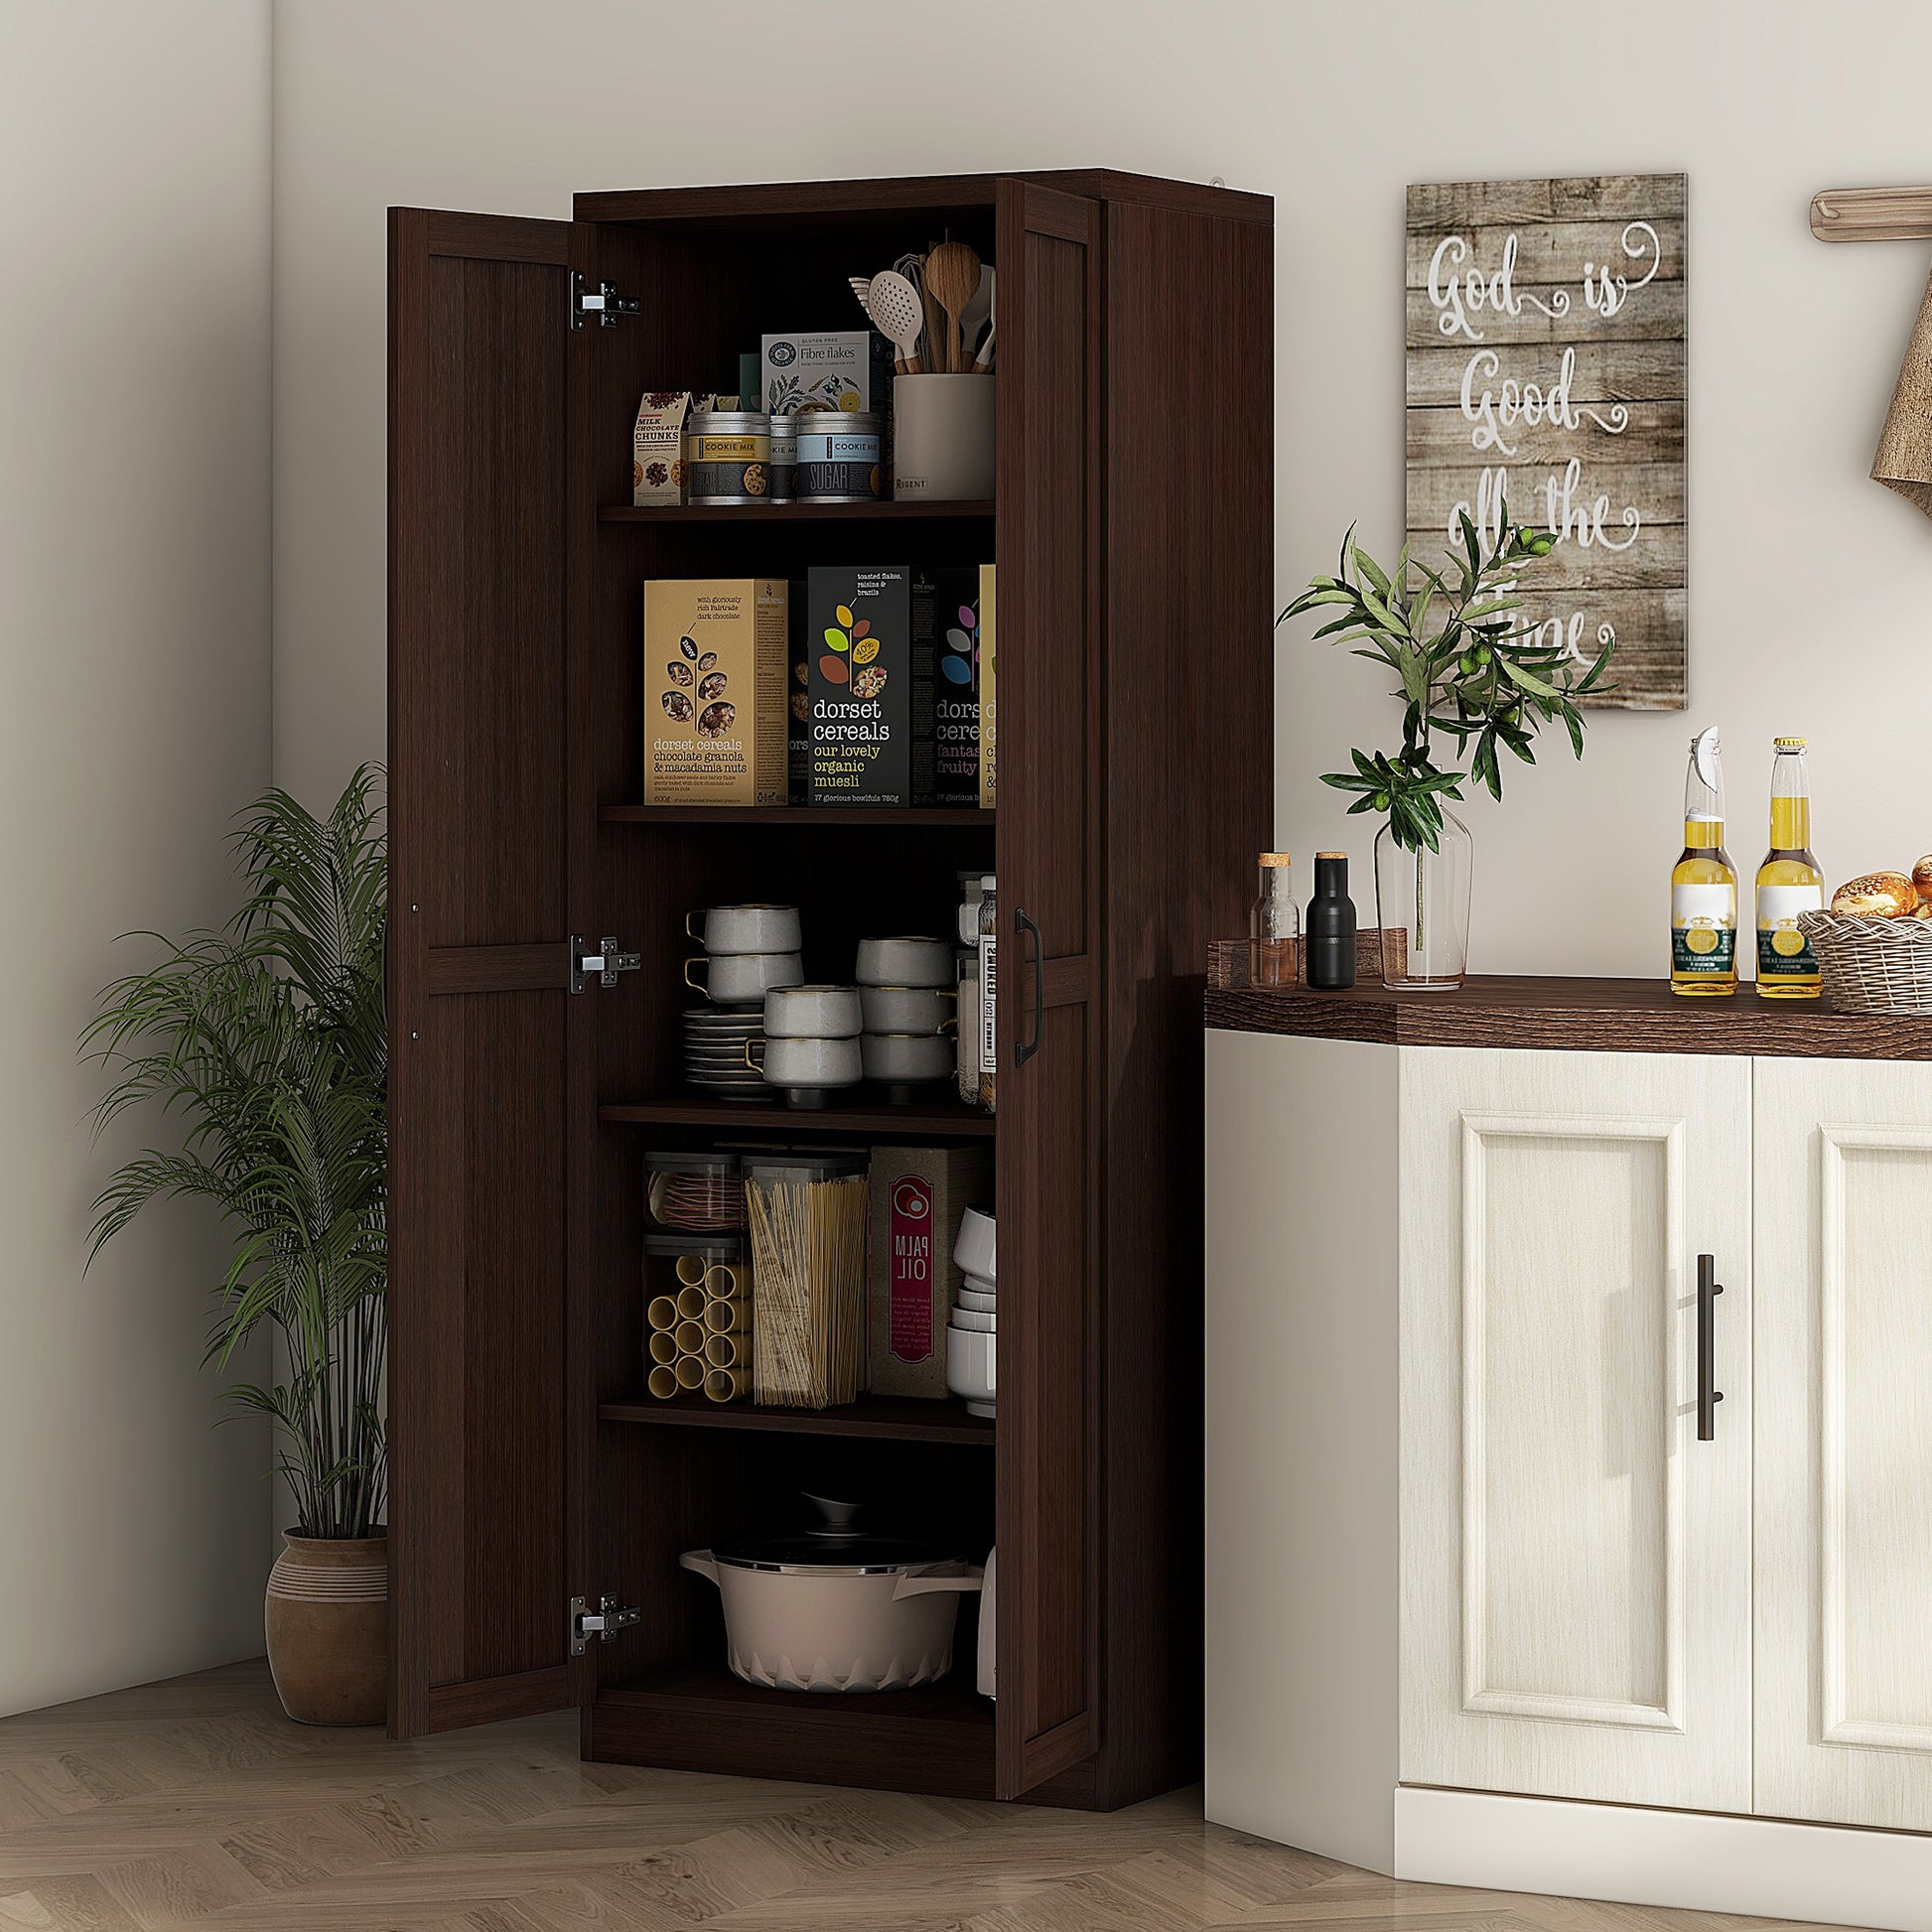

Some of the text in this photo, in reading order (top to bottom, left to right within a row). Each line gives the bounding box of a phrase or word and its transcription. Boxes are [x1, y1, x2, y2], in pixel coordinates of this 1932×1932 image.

[1428, 220, 1661, 341] God is
[800, 345, 855, 359] Fibre flakes
[1460, 346, 1628, 456] Good
[740, 443, 755, 452] MIX
[810, 464, 848, 489] SUGAR
[1449, 458, 1640, 558] all the
[681, 638, 696, 657] new
[856, 640, 875, 656] 40%
[814, 699, 882, 718] dorset
[814, 721, 890, 741] cereals
[653, 738, 743, 751] dorset cereals
[814, 745, 881, 759] our lovely
[653, 752, 745, 762] chocolate granola
[653, 762, 747, 772] & macadamia nuts
[814, 759, 865, 774] organic
[937, 759, 977, 776] fruity
[814, 775, 860, 787] muesli
